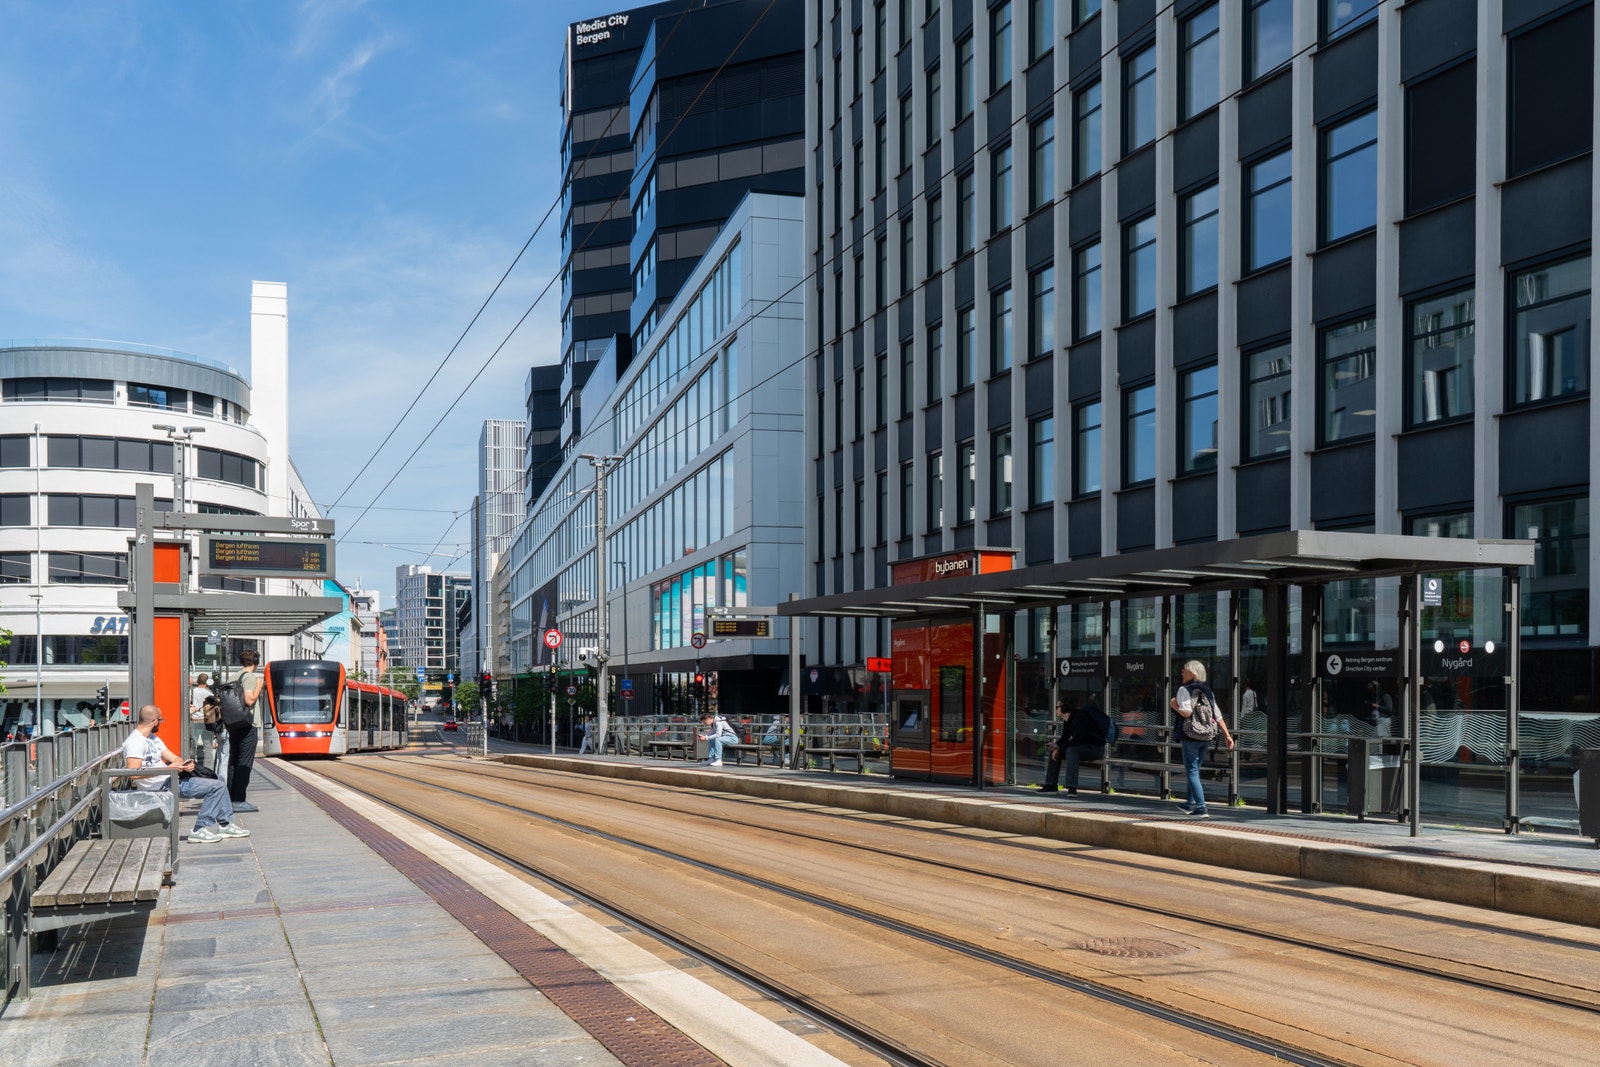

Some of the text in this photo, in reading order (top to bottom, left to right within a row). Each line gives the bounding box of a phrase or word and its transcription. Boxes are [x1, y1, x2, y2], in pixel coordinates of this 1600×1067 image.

[576, 14, 629, 34] Media City
[576, 31, 610, 45] Bergen
[291, 520, 310, 528] Spor
[311, 520, 320, 531] 1
[935, 559, 969, 575] bybanen
[1126, 662, 1145, 671] Nygård
[1441, 657, 1473, 669] Nygård
